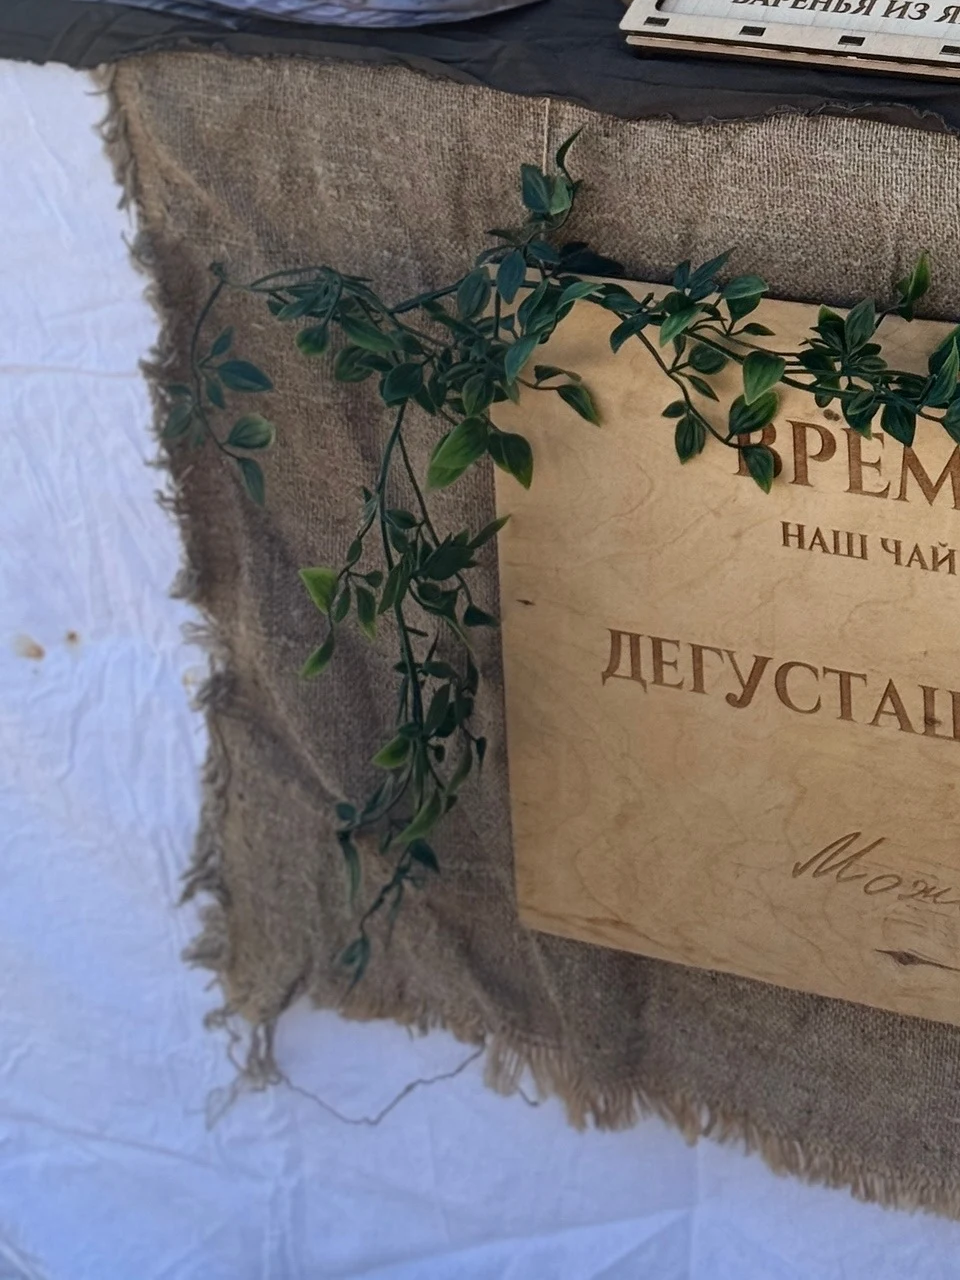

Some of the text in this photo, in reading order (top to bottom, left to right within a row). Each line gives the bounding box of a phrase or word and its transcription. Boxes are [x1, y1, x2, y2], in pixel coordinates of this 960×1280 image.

[880, 0, 931, 22] ИЗ
[780, 521, 870, 561] НАШ
[879, 535, 958, 576] ЧАЙ
